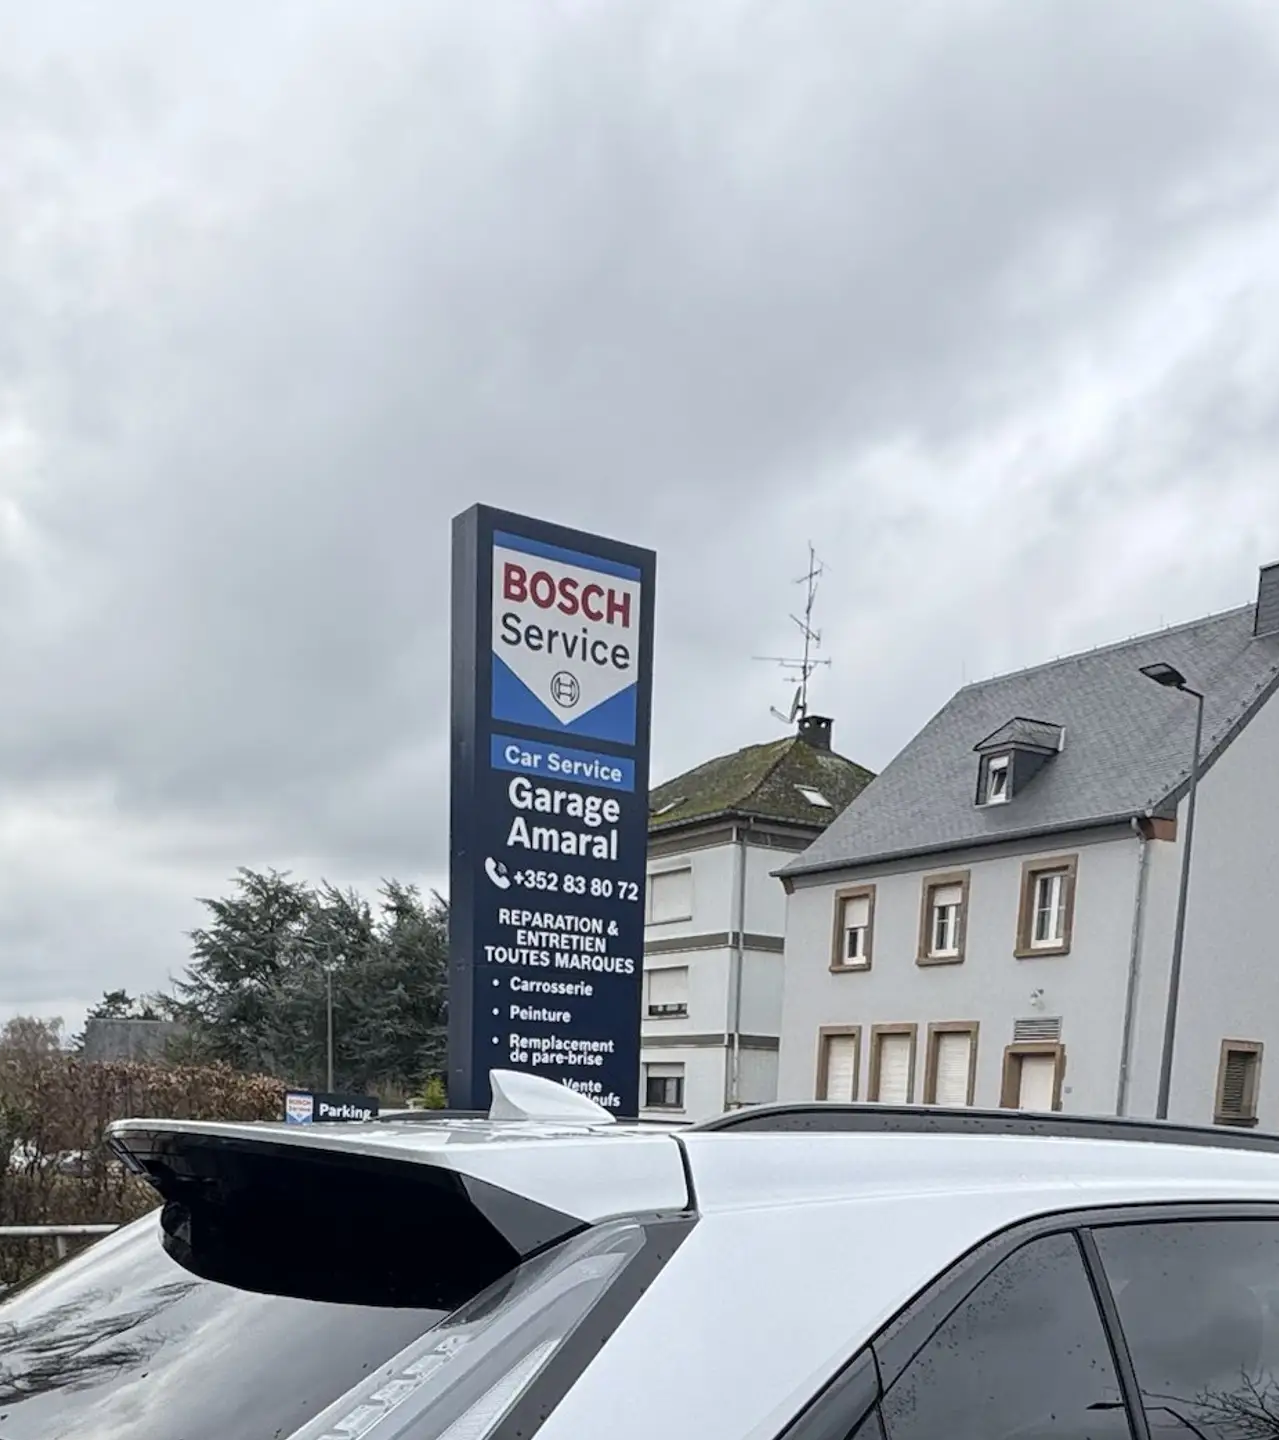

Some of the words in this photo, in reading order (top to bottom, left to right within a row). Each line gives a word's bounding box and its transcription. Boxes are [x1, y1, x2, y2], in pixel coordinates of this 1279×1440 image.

[503, 561, 631, 628] BOSCH
[501, 612, 630, 669] Service
[505, 745, 541, 768] Car
[548, 754, 622, 782] Service
[508, 777, 620, 826] Garage
[506, 817, 618, 860] Amaral
[513, 869, 558, 892] +352
[563, 876, 586, 894] 83
[590, 879, 612, 897] 80
[618, 880, 639, 900] 72
[498, 908, 603, 934] REPARATION
[607, 918, 619, 936] &
[517, 930, 606, 953] ENTRETIEN
[485, 946, 550, 967] TOUTES
[555, 954, 634, 974] MARQUES
[509, 976, 593, 996] Carrosserie
[509, 1005, 571, 1023] Peinture
[509, 1033, 614, 1053] Remplacement
[509, 1048, 528, 1063] de
[532, 1051, 603, 1066] pare-brise
[562, 1077, 602, 1093] Vente
[319, 1103, 372, 1121] Parking
